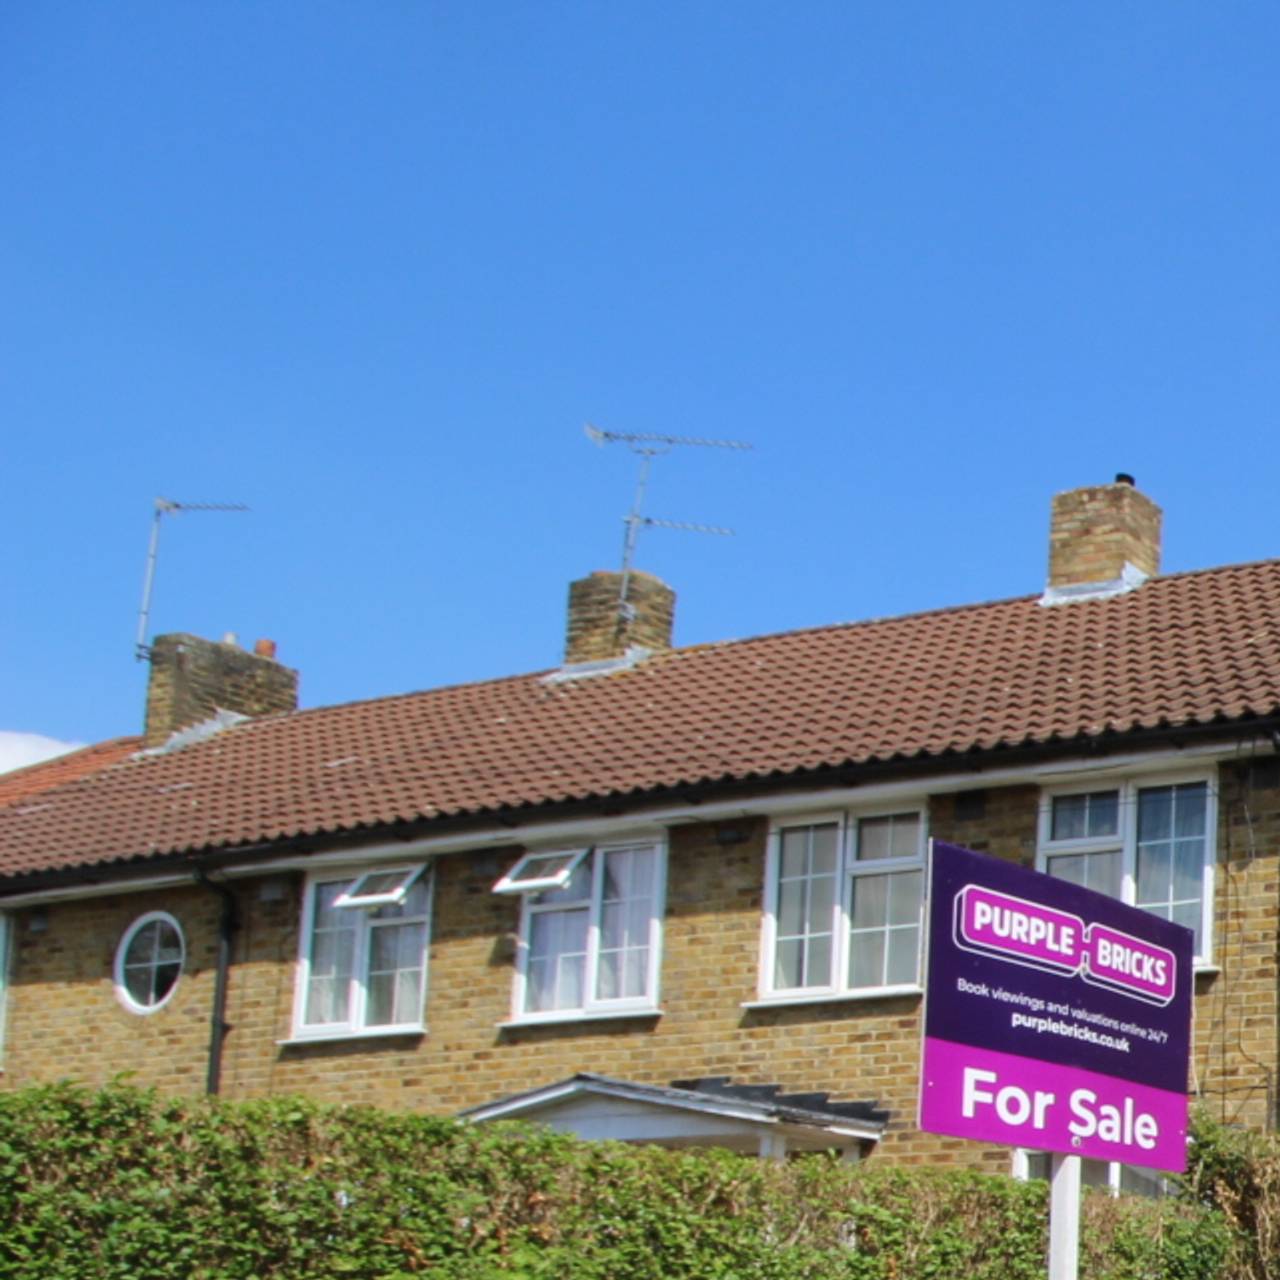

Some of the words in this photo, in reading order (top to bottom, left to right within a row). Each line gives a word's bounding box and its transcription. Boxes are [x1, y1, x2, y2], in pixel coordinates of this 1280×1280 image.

[973, 901, 1074, 955] PURPLE
[1096, 938, 1166, 986] BRICKS
[957, 977, 989, 998] Book
[991, 986, 1045, 1011] viewings
[1046, 1001, 1069, 1016] and
[1070, 1007, 1120, 1031] valuations
[1120, 1022, 1147, 1040] online
[1147, 1028, 1168, 1045] 24/7
[1011, 1012, 1131, 1053] purplebricks.co.uk
[961, 1066, 1055, 1130] For
[1068, 1088, 1158, 1150] Sale
